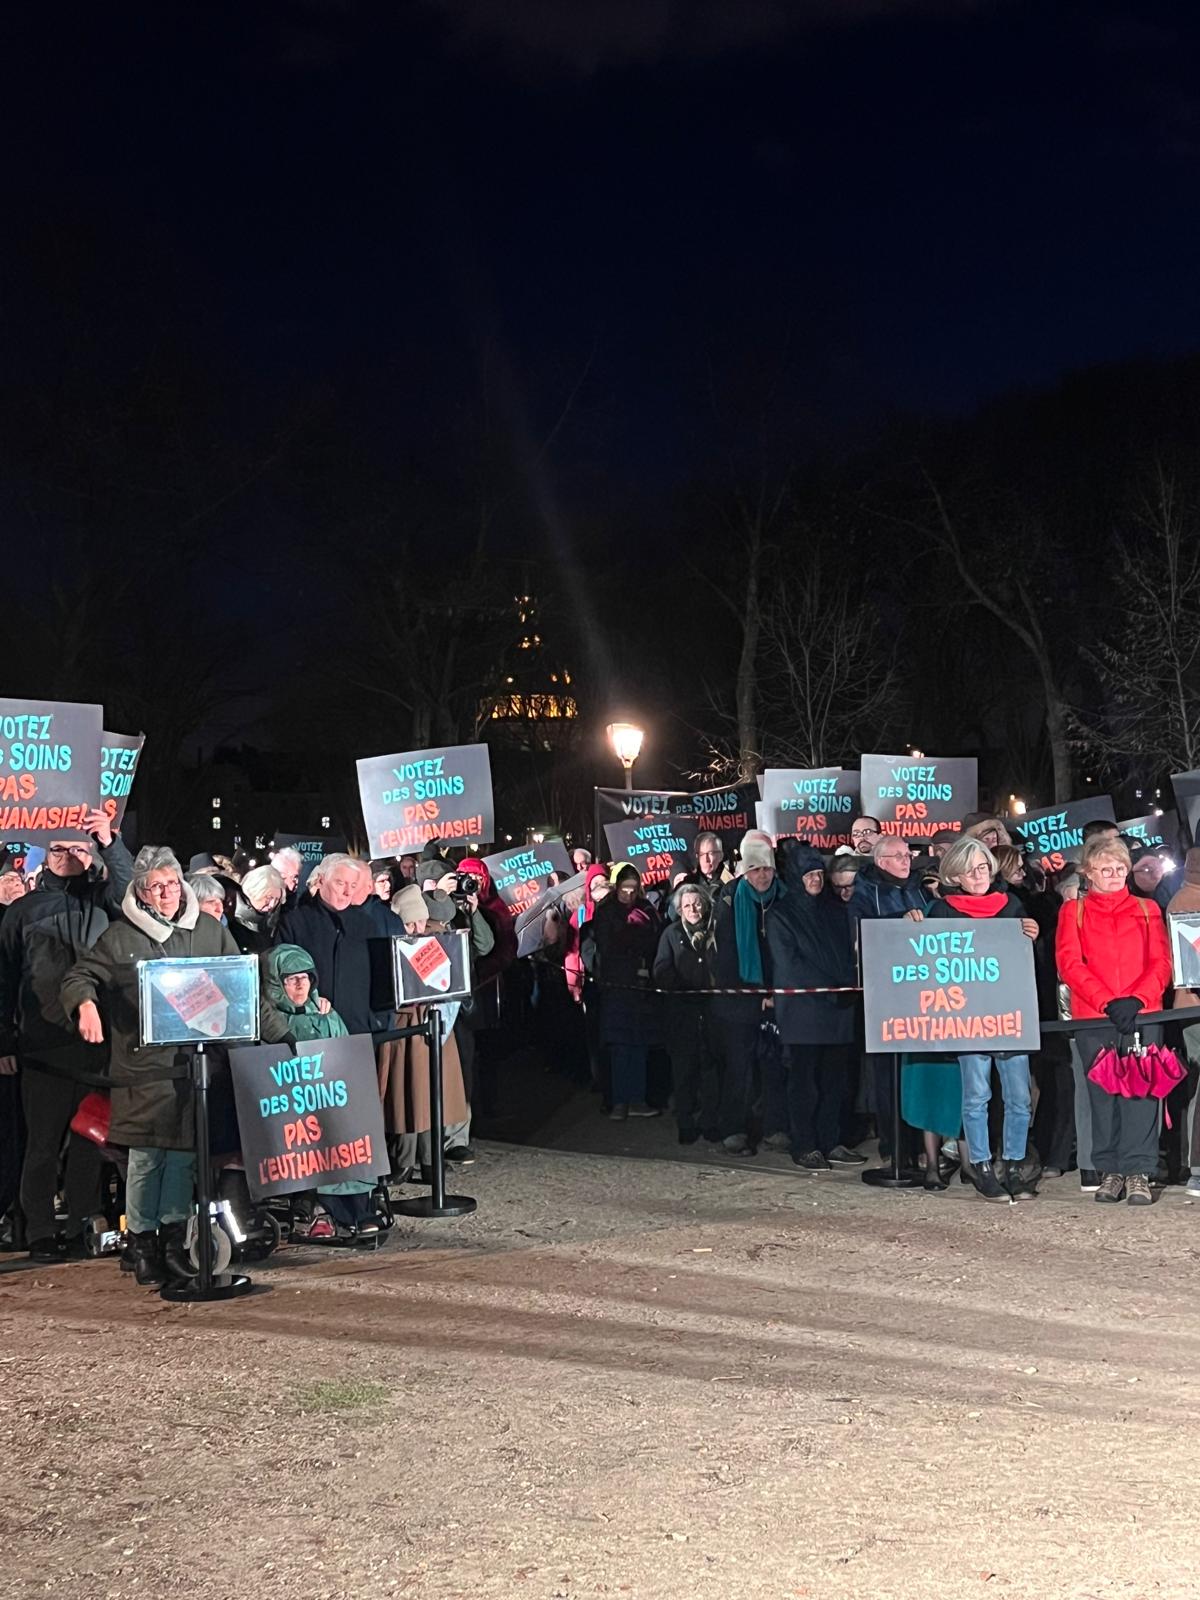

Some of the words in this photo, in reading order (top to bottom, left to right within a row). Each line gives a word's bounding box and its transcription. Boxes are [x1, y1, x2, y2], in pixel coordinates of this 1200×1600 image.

[0, 714, 52, 740] OTEZ
[9, 743, 71, 771] SOINS
[101, 747, 139, 770] OTEZ
[393, 756, 445, 782] VOTEZ
[793, 777, 838, 794] VOTEZ
[891, 766, 937, 781] VOTEZ
[382, 786, 410, 804] DES
[414, 775, 465, 799] SOINS
[878, 787, 903, 798] DES
[907, 783, 952, 801] SOINS
[403, 800, 440, 824] PAS
[621, 795, 672, 815] VOTEZ
[675, 804, 693, 814] DES
[693, 793, 738, 814] SOINS
[781, 798, 805, 811] DES
[808, 795, 852, 813] SOINS
[895, 802, 928, 820] PAS
[380, 814, 482, 849] L'EUTHANASIE!
[634, 823, 672, 840] VOTEZ
[698, 812, 748, 831] ANASIE!
[796, 814, 827, 831] PAS
[1016, 811, 1068, 838] VOTEZ
[627, 845, 650, 856] DES
[652, 838, 688, 853] SOINS
[500, 849, 537, 872] VOTEZ
[647, 853, 674, 870] PAS
[495, 874, 516, 890] DES
[517, 860, 553, 882] SOINS
[514, 880, 540, 901] PAS
[909, 930, 975, 957] VOTEZ
[892, 965, 929, 983] DES
[935, 957, 1000, 984] SOINS
[920, 985, 967, 1014] PAS
[882, 1010, 1022, 1041] L'EUTHANASIE!
[269, 1051, 324, 1087] VOTEZ
[259, 1094, 289, 1118] DES
[291, 1080, 348, 1114] SOINS
[284, 1115, 322, 1149] PAS
[259, 1135, 372, 1185] L'EUTHANASIE!
